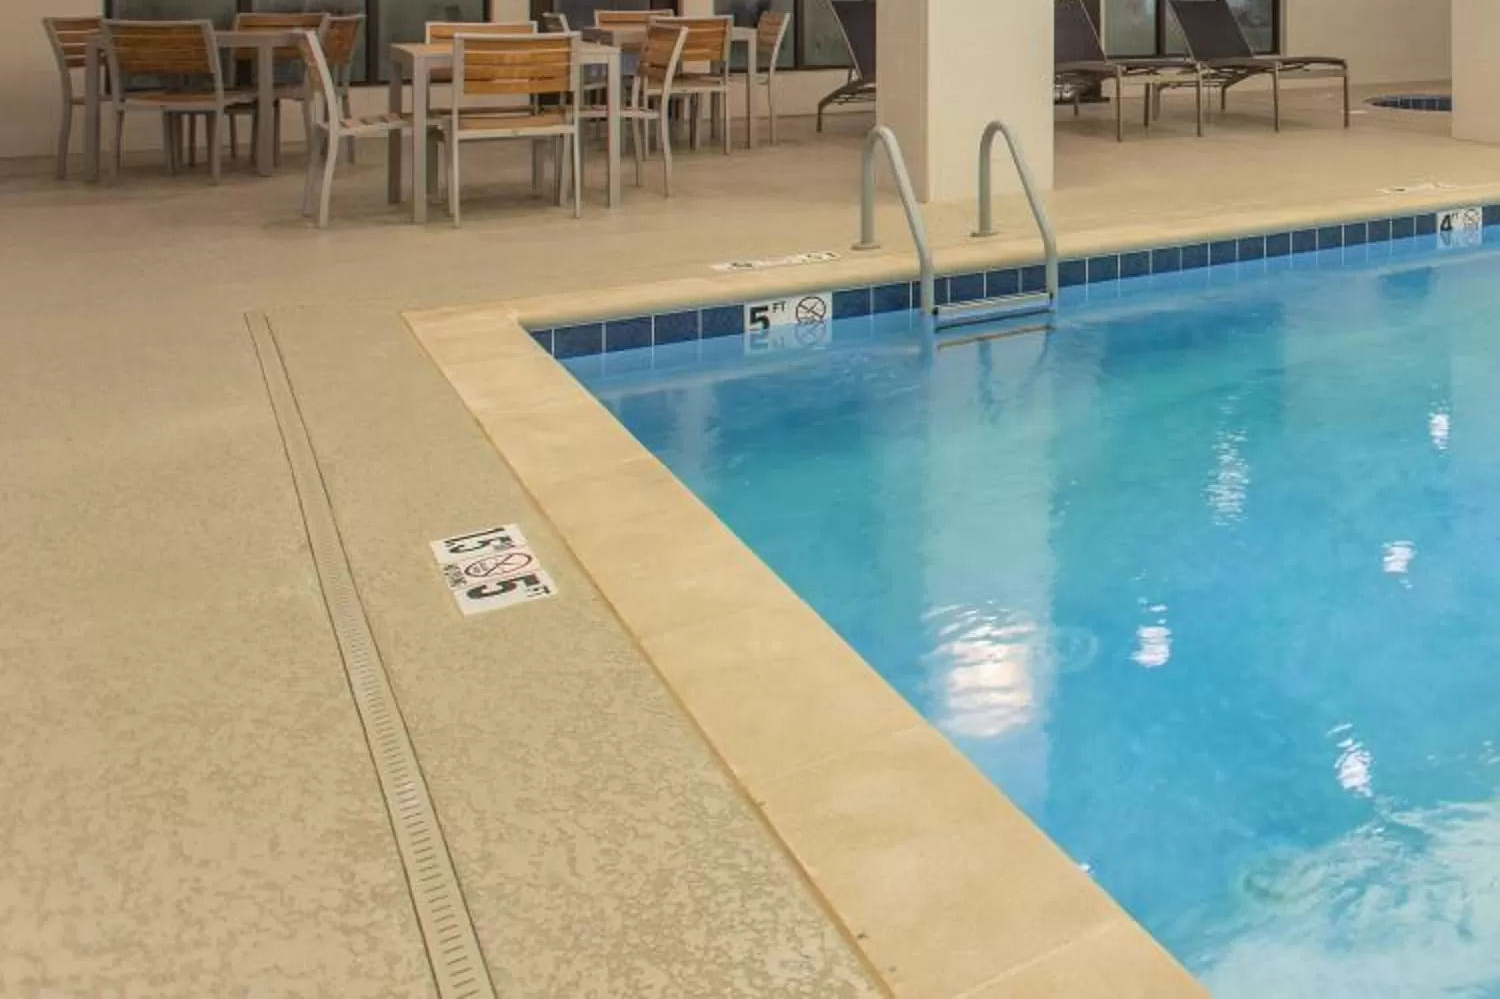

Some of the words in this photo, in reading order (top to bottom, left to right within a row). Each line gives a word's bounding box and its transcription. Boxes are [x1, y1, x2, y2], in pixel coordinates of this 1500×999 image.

[1440, 214, 1453, 231] 4
[750, 305, 770, 330] 5
[772, 302, 786, 313] FT
[467, 574, 540, 599] 5
